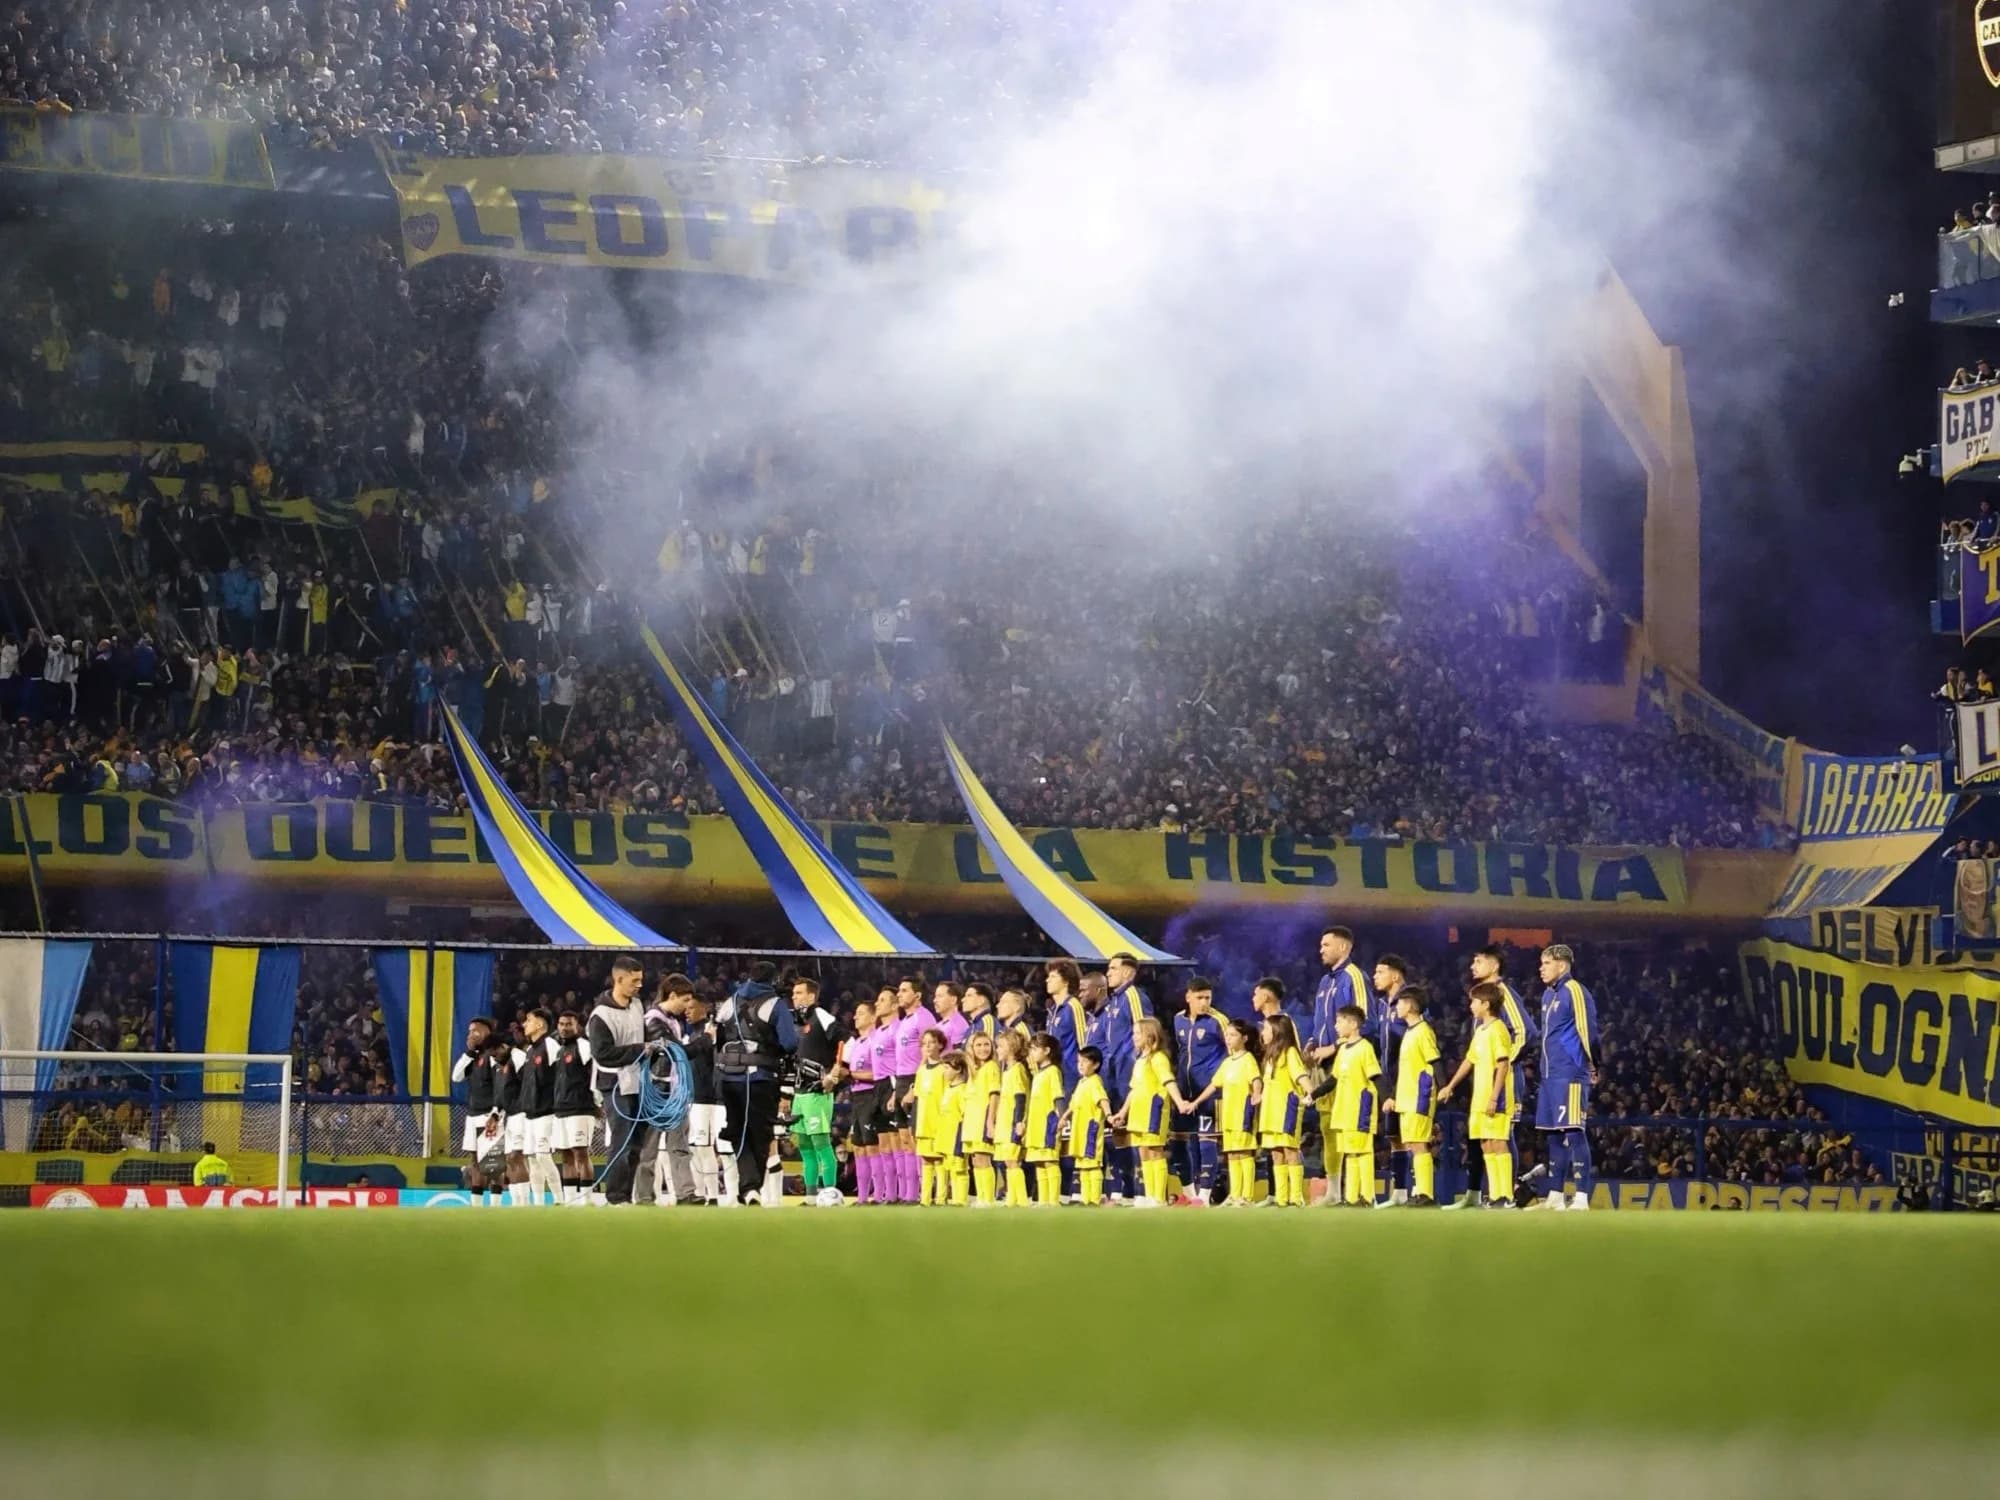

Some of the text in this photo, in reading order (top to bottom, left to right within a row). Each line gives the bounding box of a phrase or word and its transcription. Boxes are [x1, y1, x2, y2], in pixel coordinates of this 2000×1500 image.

[1946, 394, 2000, 445] GAB
[0, 793, 195, 860] LOS
[245, 797, 693, 868] DUEOS
[1164, 831, 1669, 901] HISTORIA
[1745, 954, 2000, 1110] BOULOGN
[1199, 1115, 1213, 1132] 17
[1558, 1105, 1567, 1123] 7
